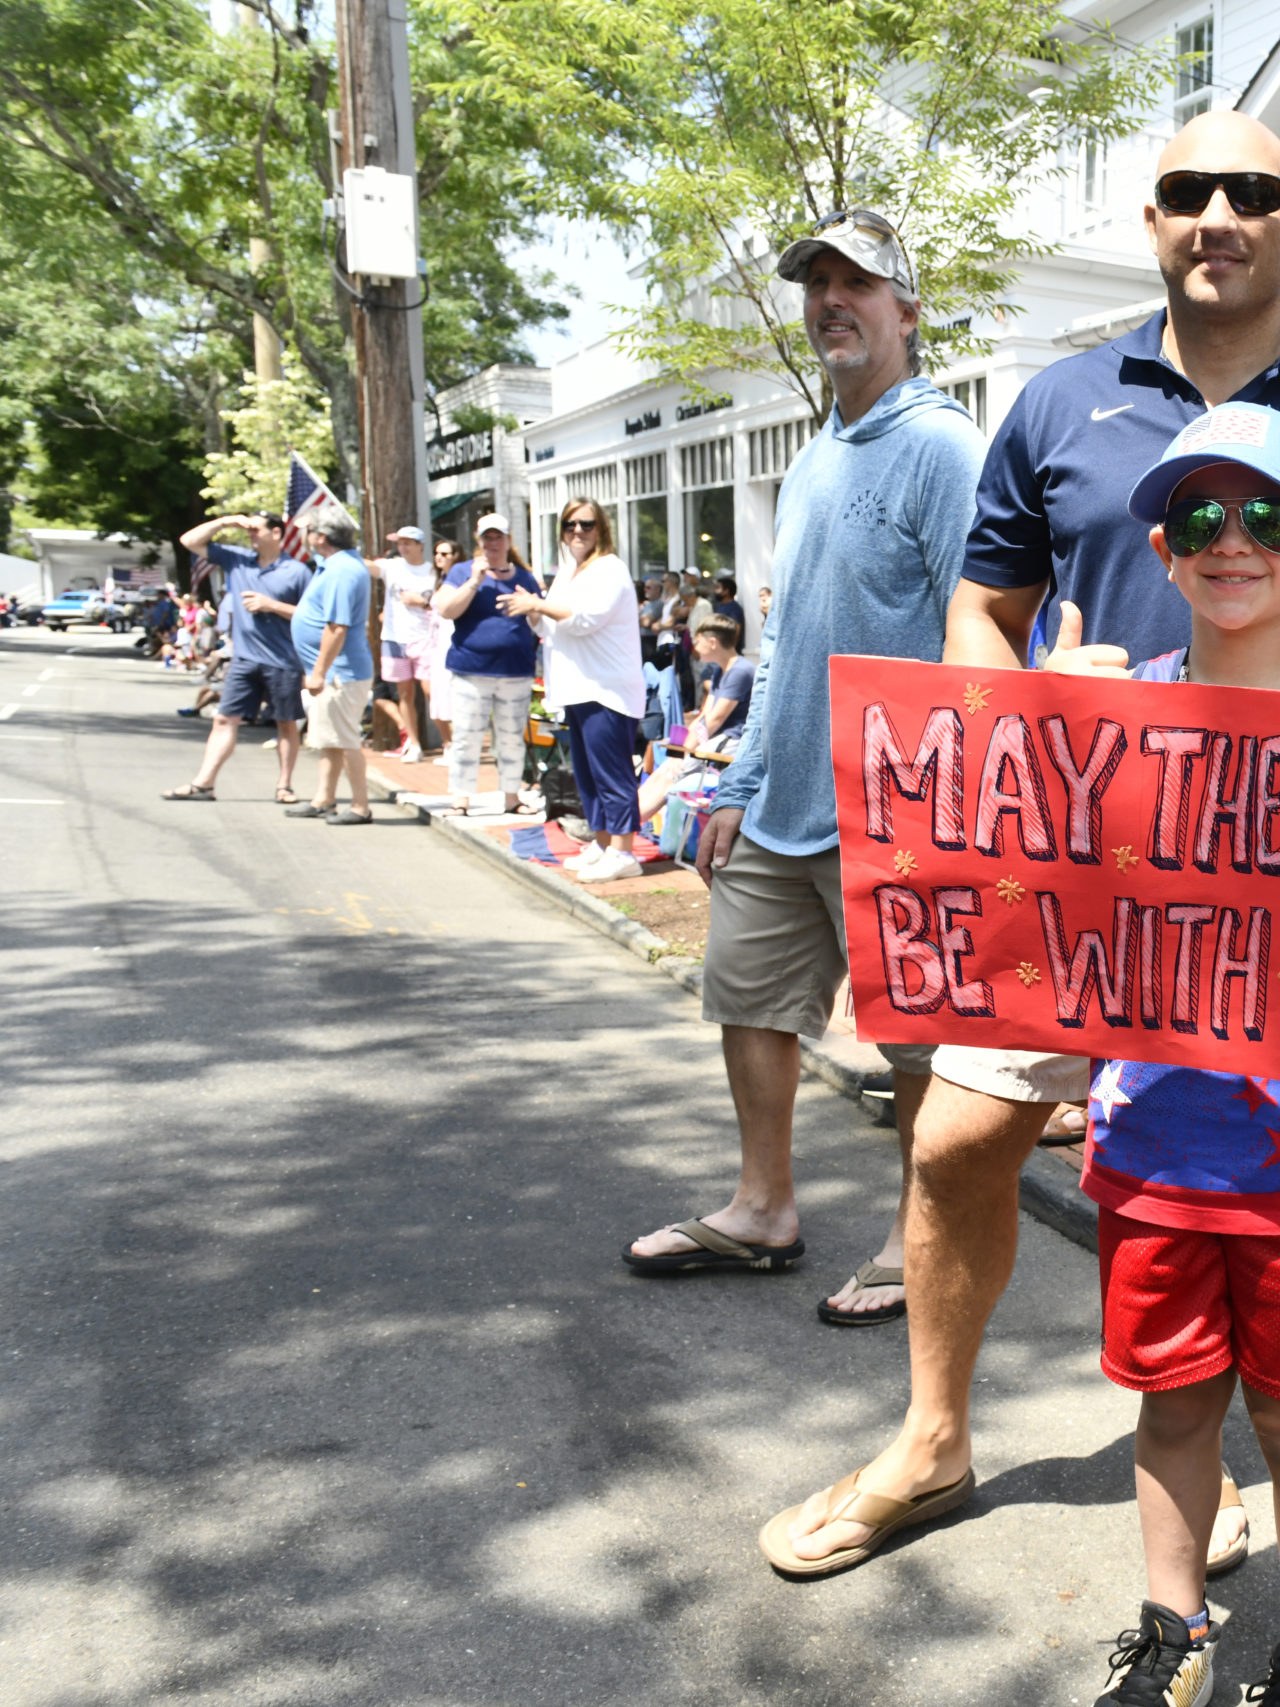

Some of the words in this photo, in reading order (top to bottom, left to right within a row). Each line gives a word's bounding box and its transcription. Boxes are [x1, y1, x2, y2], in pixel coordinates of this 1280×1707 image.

[863, 702, 1129, 864] MAY
[873, 883, 996, 1018] BE
[1035, 891, 1272, 1040] WITH
